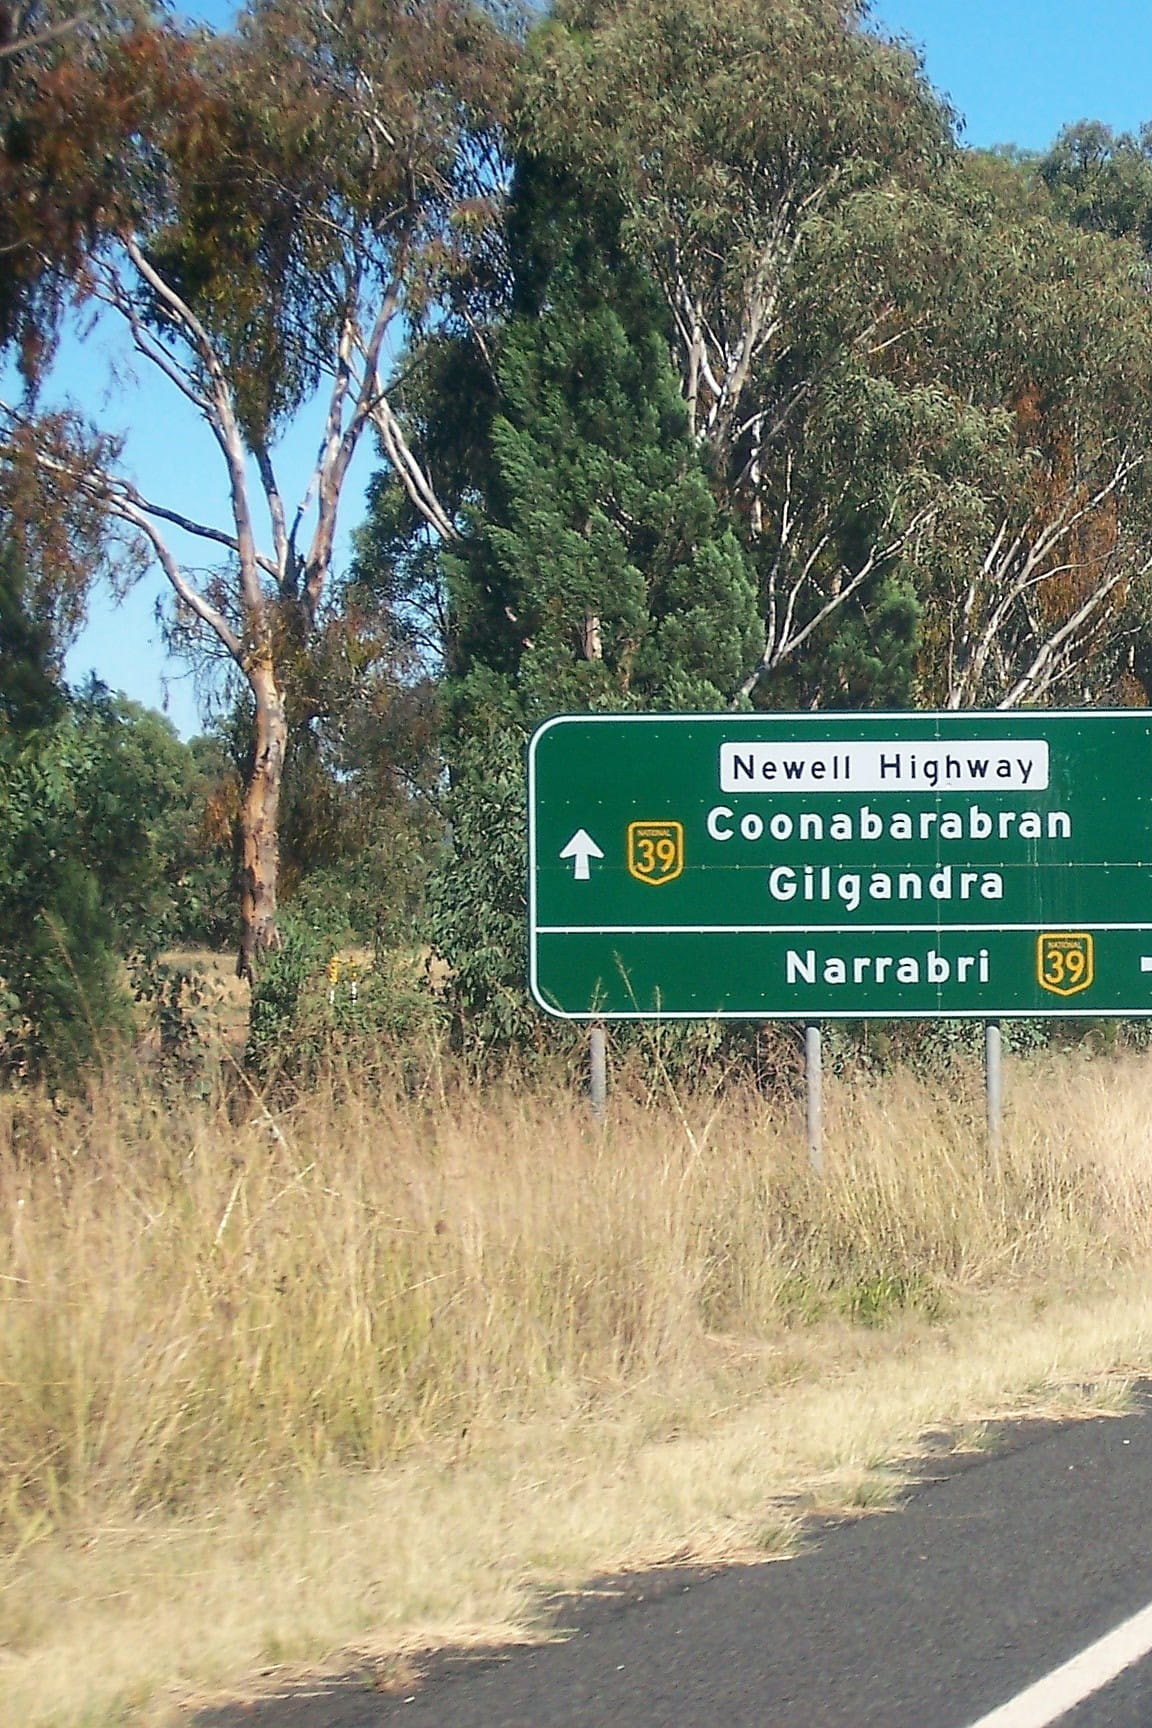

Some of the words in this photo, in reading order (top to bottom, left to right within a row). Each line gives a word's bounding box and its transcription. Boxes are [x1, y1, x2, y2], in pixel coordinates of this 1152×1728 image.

[733, 754, 850, 780] Newell
[880, 753, 1034, 787] Highway
[707, 805, 1072, 841] Coonabarabran
[636, 838, 676, 873] 39
[769, 865, 1003, 911] Gilgandra
[786, 949, 989, 984] Narrabri
[1045, 949, 1086, 984] 39
